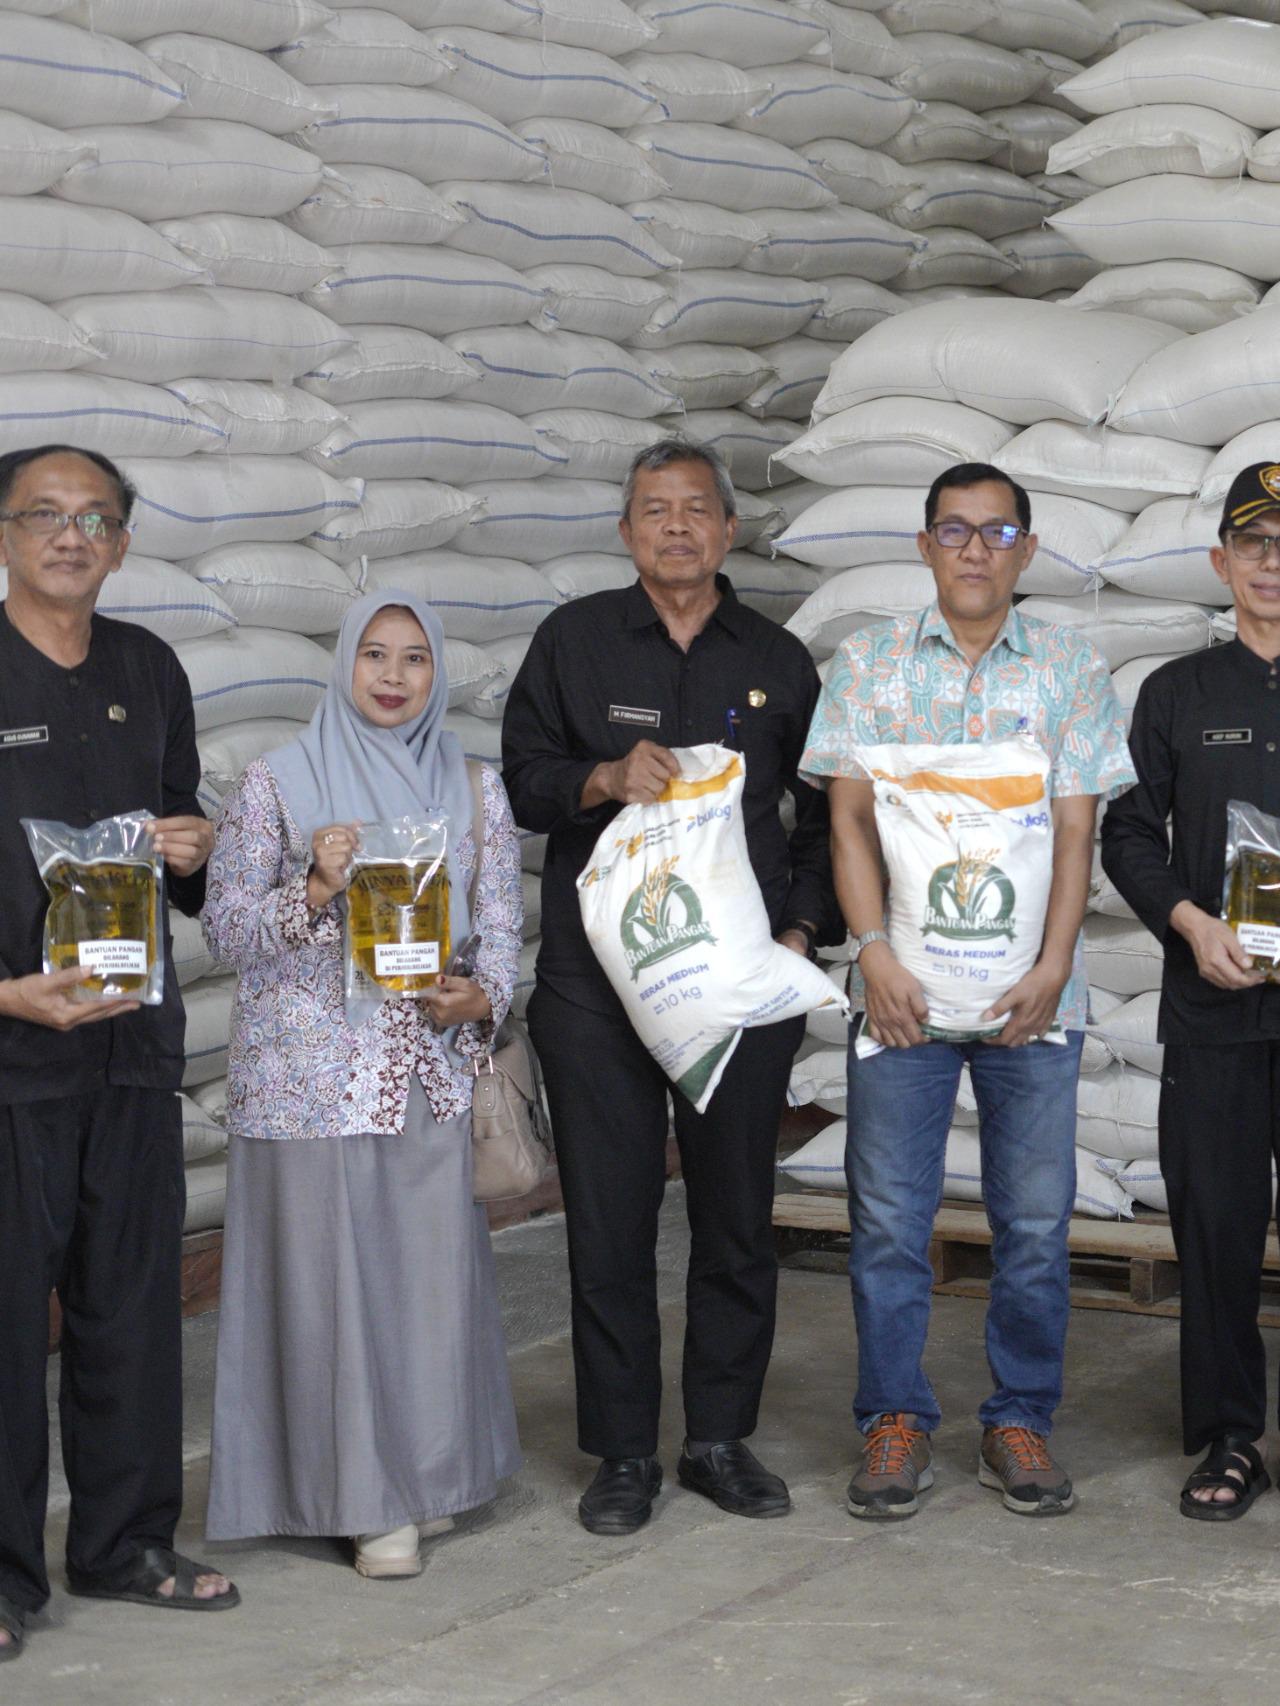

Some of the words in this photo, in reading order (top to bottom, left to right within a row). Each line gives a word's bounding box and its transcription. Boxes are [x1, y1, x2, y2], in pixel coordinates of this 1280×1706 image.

[696, 804, 732, 827] bulog
[924, 904, 973, 929] BANTUAN
[973, 912, 1016, 930] PANGAN
[84, 945, 117, 955] BANTUAN
[118, 945, 143, 954] PANGAN
[379, 949, 410, 957] BANTUAN
[411, 947, 435, 956] PANGAN
[623, 935, 668, 970] BANTUAN
[665, 919, 712, 944] PANGAN
[925, 944, 960, 957] BERAS
[963, 949, 1006, 959] MEDIUM
[639, 979, 666, 1001] BERAS
[666, 963, 710, 984] MEDIUM
[968, 965, 990, 982] kg
[679, 985, 704, 1001] kg
